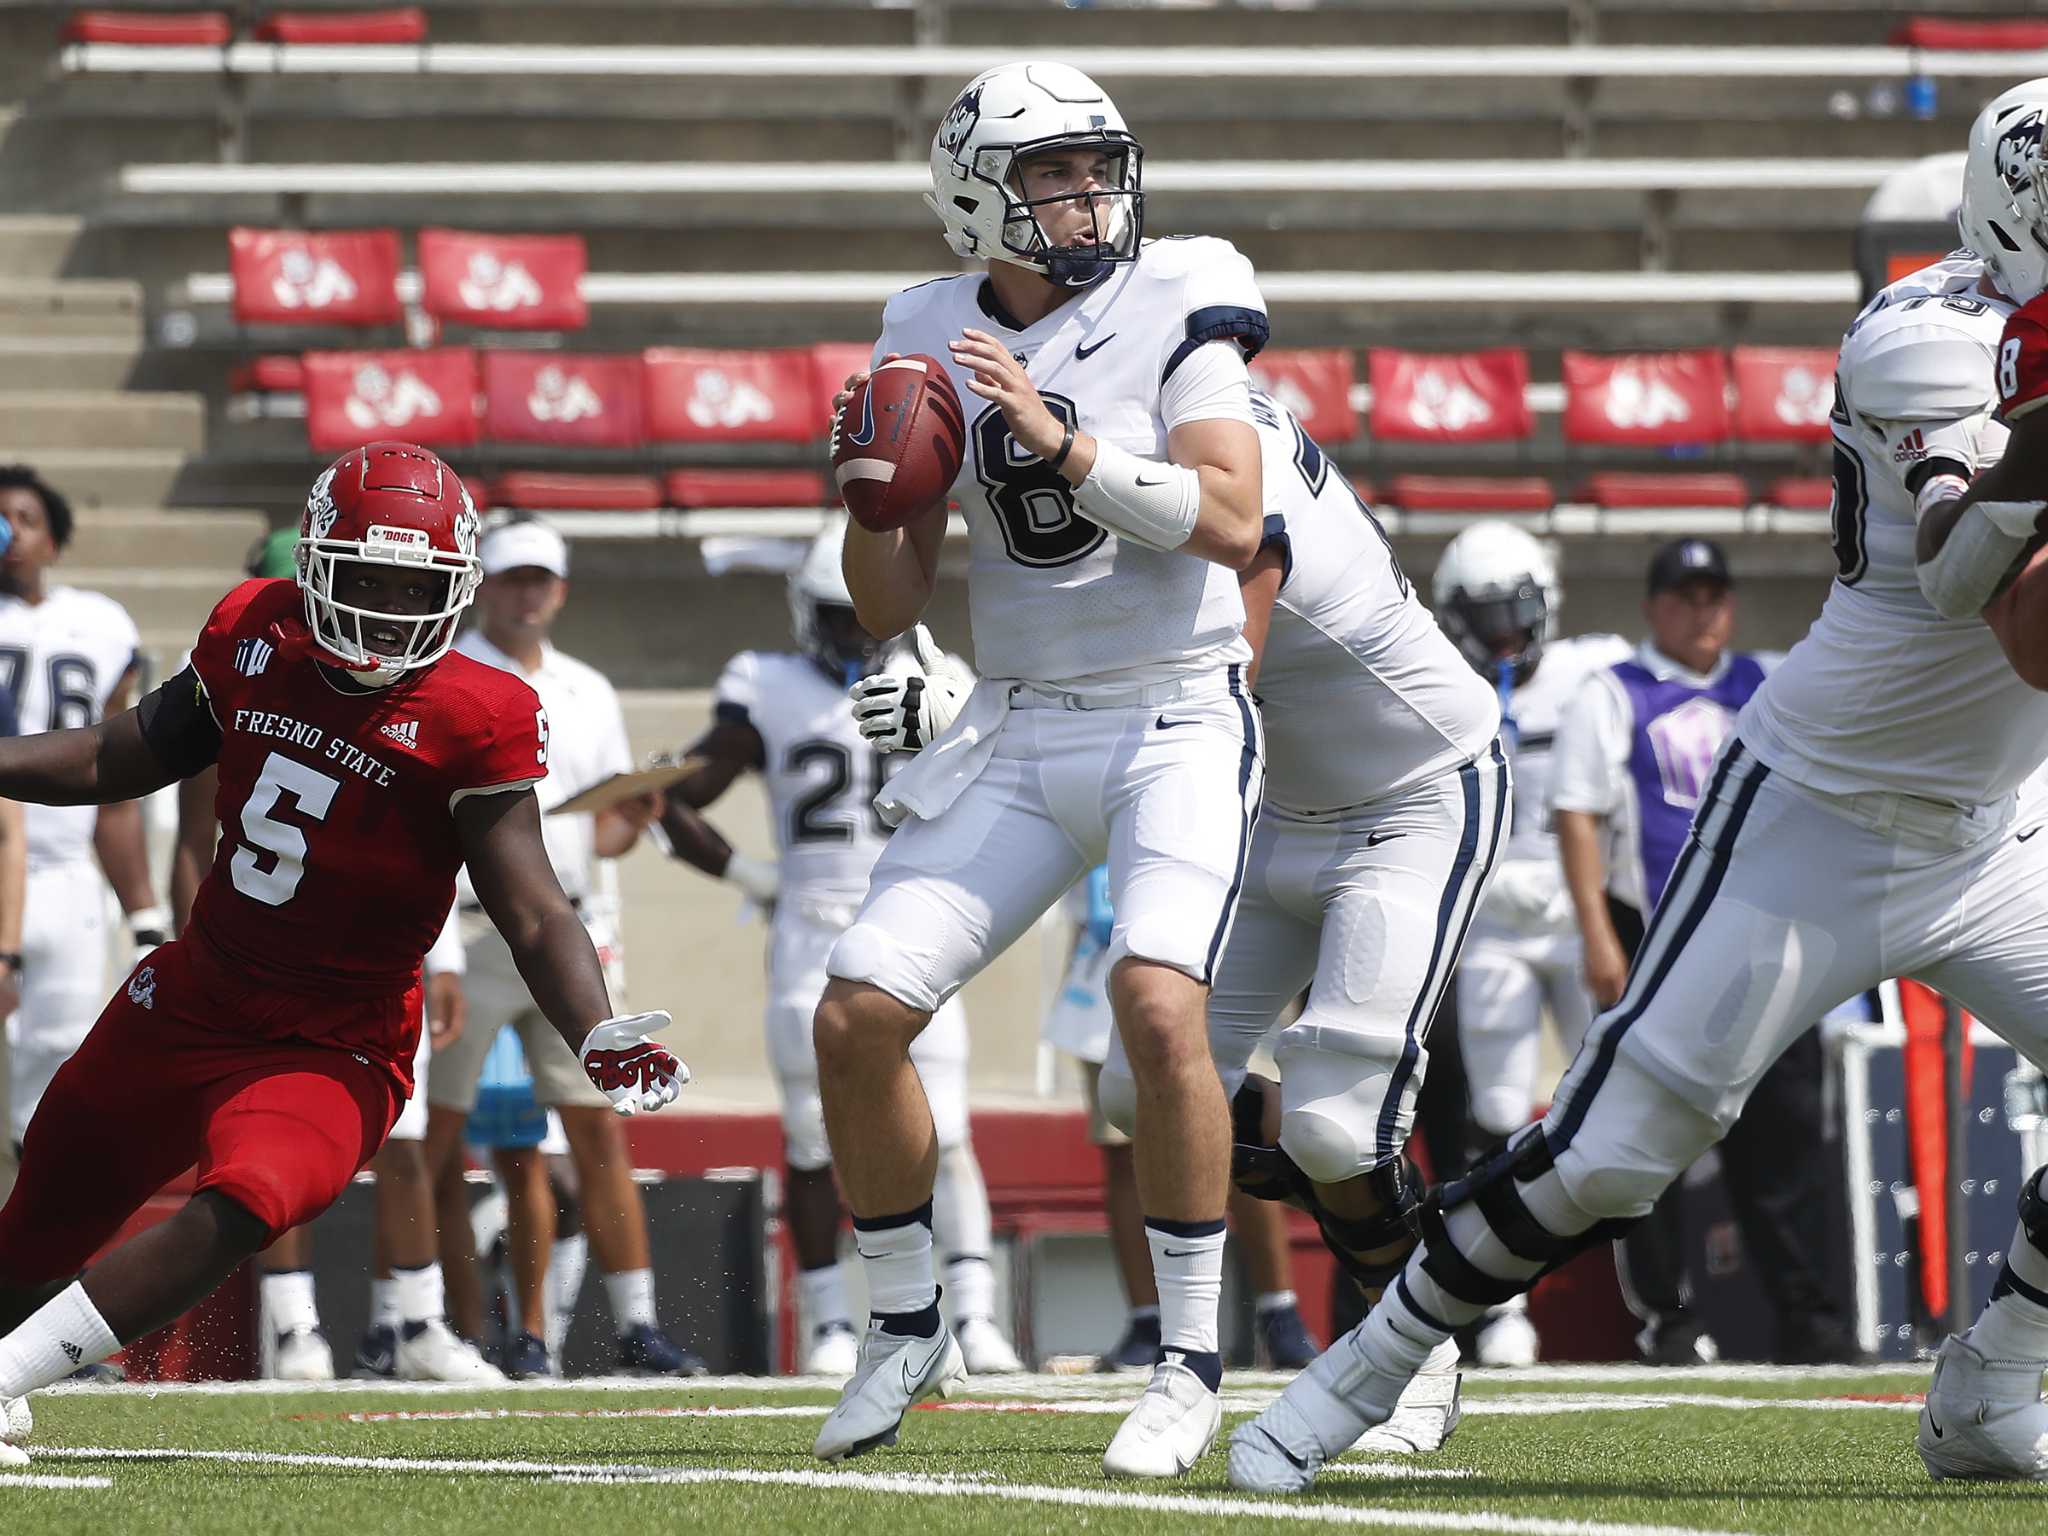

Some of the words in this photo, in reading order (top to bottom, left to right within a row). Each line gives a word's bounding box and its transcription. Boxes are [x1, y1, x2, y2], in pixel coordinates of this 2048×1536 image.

[2000, 337, 2021, 399] 8
[972, 390, 1109, 569] 8
[383, 530, 415, 543] 'DOGS
[234, 709, 323, 749] FRESNO
[325, 737, 397, 788] STATE
[379, 723, 417, 750] adidas
[230, 751, 341, 907] 5
